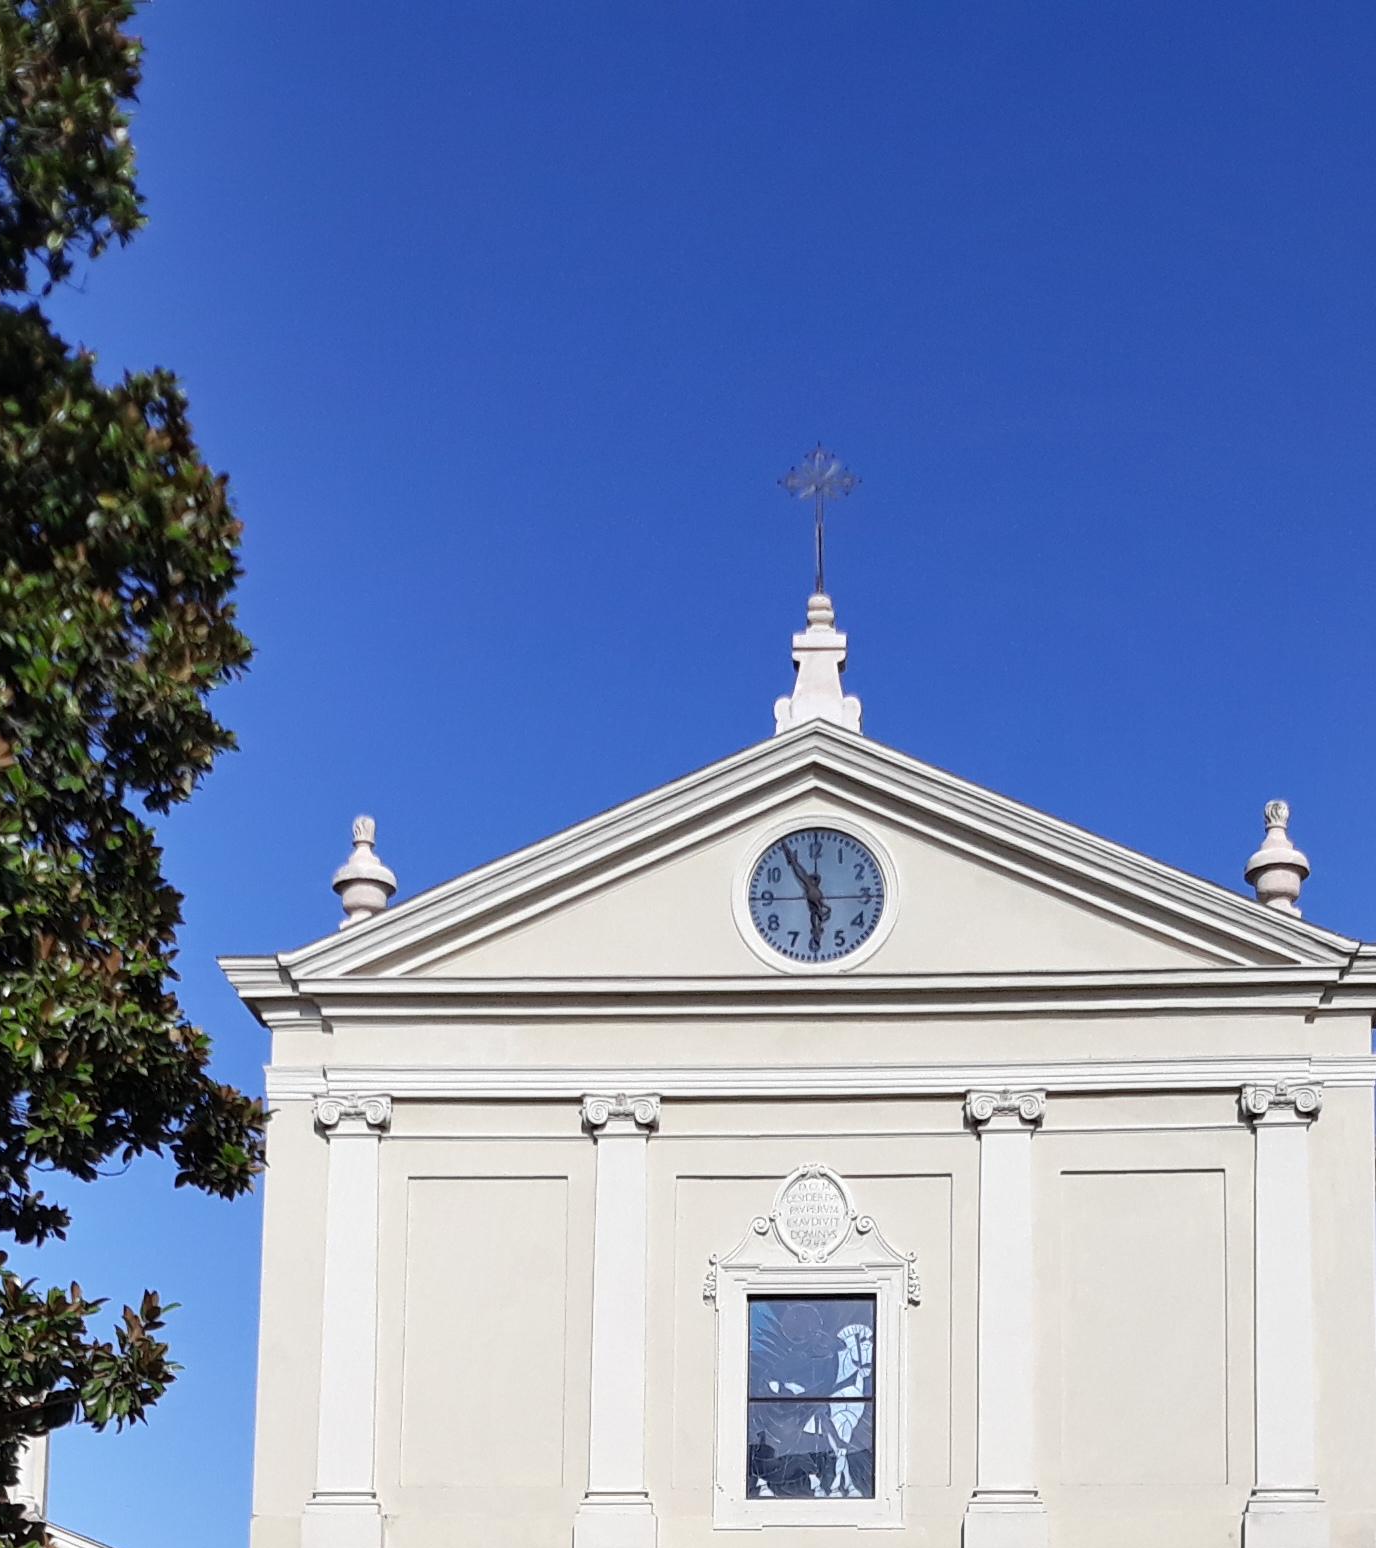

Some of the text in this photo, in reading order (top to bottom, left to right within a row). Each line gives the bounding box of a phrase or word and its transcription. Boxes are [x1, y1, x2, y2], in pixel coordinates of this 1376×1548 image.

[809, 843, 823, 859] 12
[837, 847, 843, 864] 1
[767, 867, 781, 884] 10
[853, 863, 865, 881] 2
[761, 891, 774, 907] 9
[859, 888, 872, 905] 3
[768, 914, 780, 931] 8
[851, 911, 865, 929] 4
[787, 931, 800, 948] 7
[834, 930, 846, 947] 5
